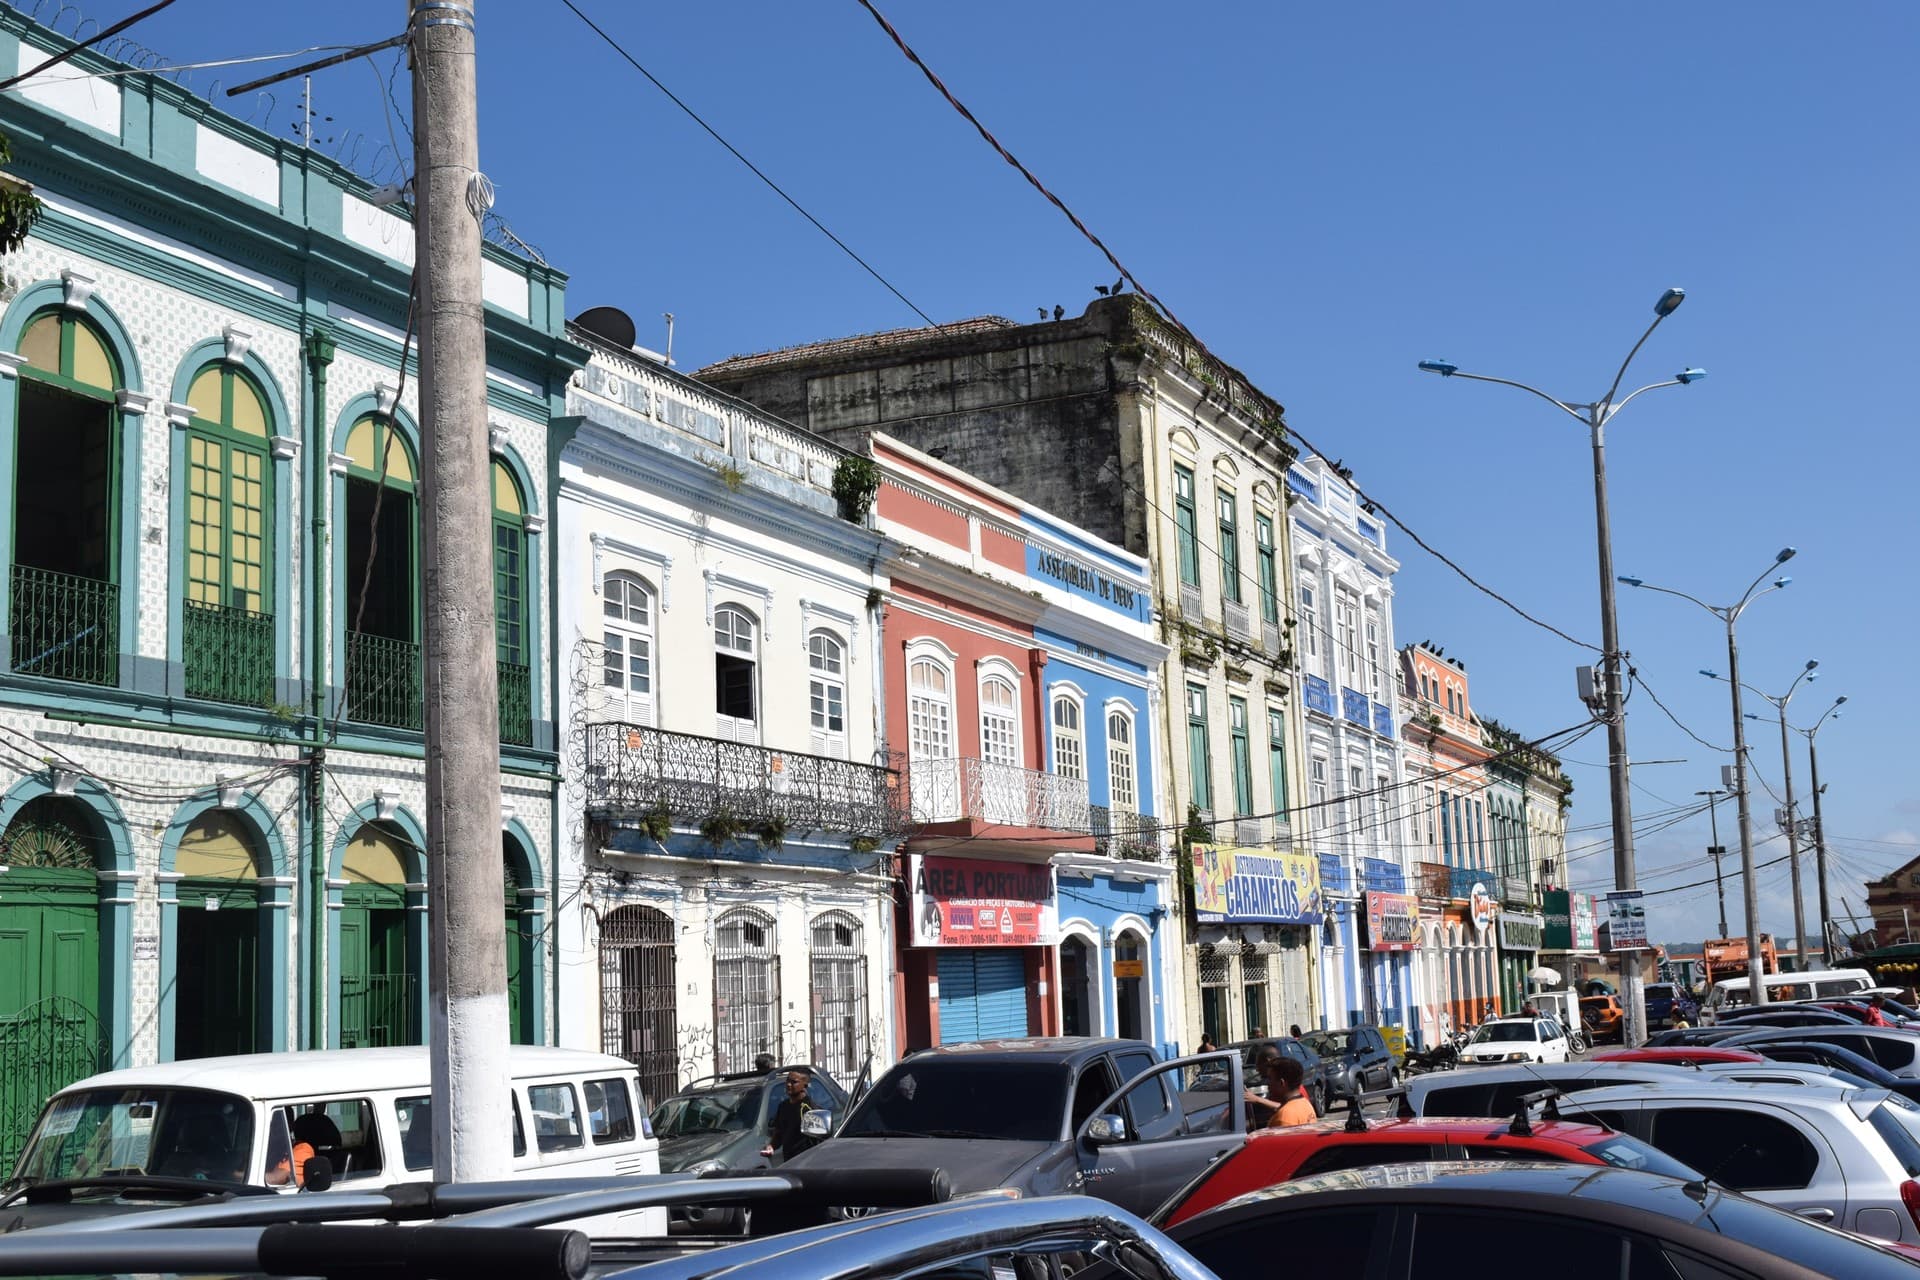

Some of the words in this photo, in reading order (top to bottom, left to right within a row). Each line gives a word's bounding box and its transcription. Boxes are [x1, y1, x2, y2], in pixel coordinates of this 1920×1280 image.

[1037, 552, 1095, 593] ASSEMBLEIA
[1099, 577, 1110, 600] DE
[1113, 584, 1134, 610] DEUS
[1225, 875, 1299, 919] CARAMELOS
